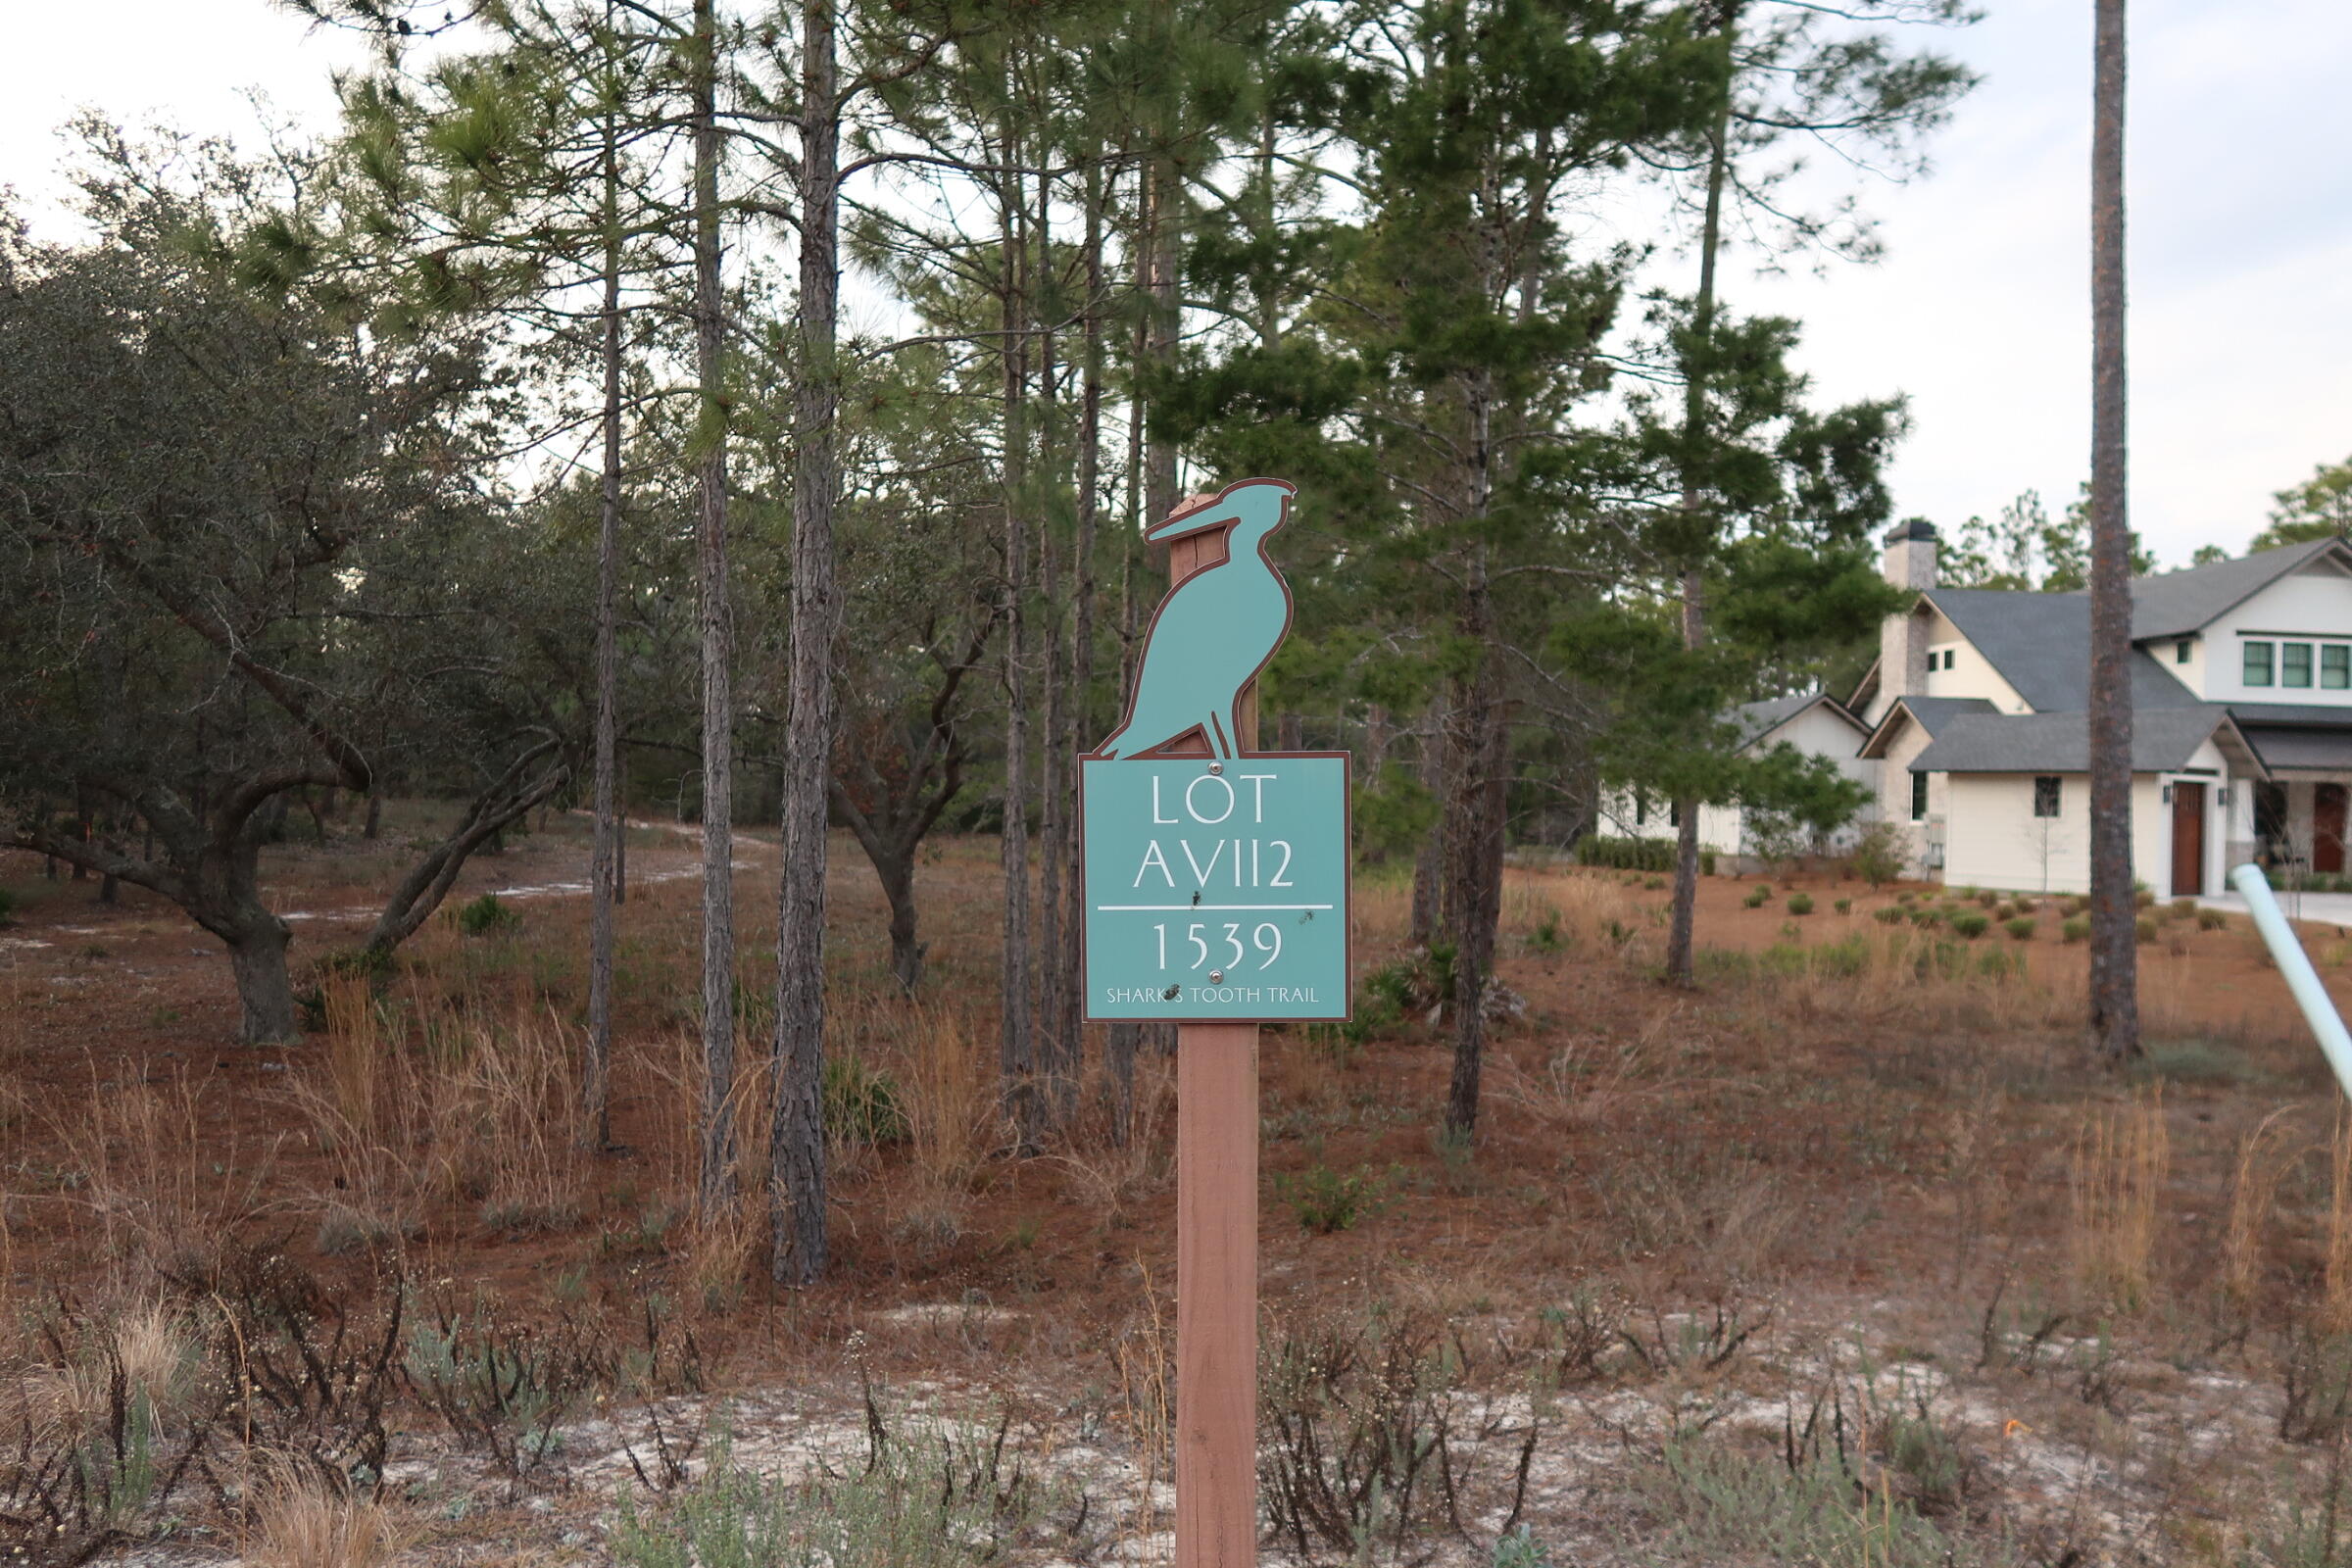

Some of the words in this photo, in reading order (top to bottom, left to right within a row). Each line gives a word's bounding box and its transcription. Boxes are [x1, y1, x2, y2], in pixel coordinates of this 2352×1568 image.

[1152, 775, 1277, 824] LOT
[1153, 922, 1282, 970] 1539
[1106, 987, 1183, 1004] SHARKS
[1190, 988, 1260, 1003] TOOTH
[1267, 988, 1319, 1003] TRAIL
